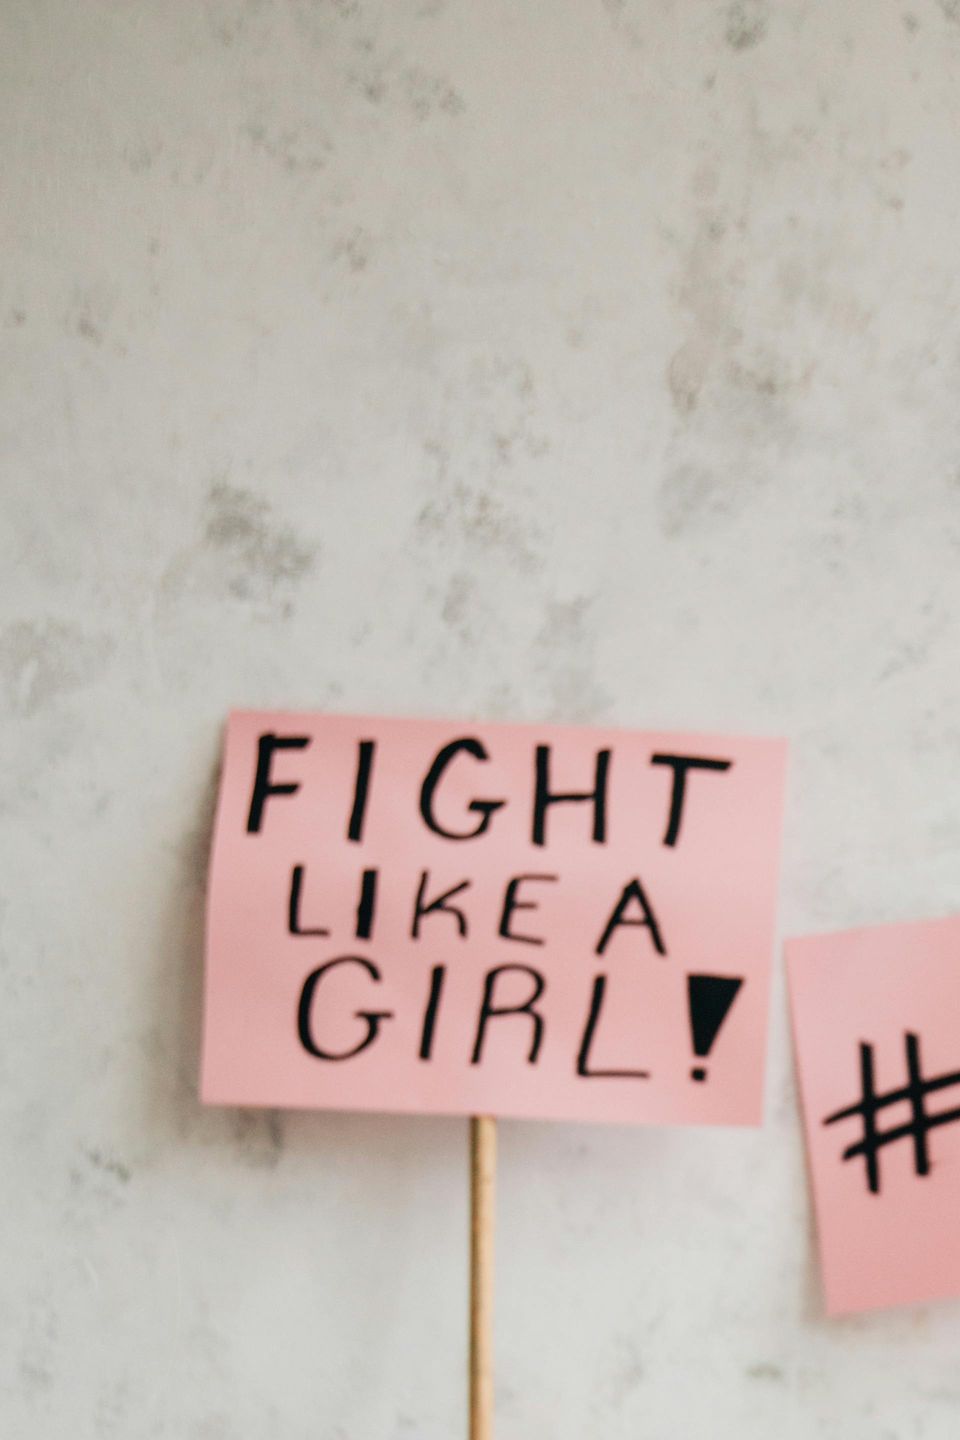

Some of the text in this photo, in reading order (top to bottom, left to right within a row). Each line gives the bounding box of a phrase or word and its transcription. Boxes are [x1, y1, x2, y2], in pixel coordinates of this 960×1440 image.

[246, 733, 733, 847] FIGHT
[287, 863, 667, 957] LIKE A
[296, 955, 746, 1082] GIRL!
